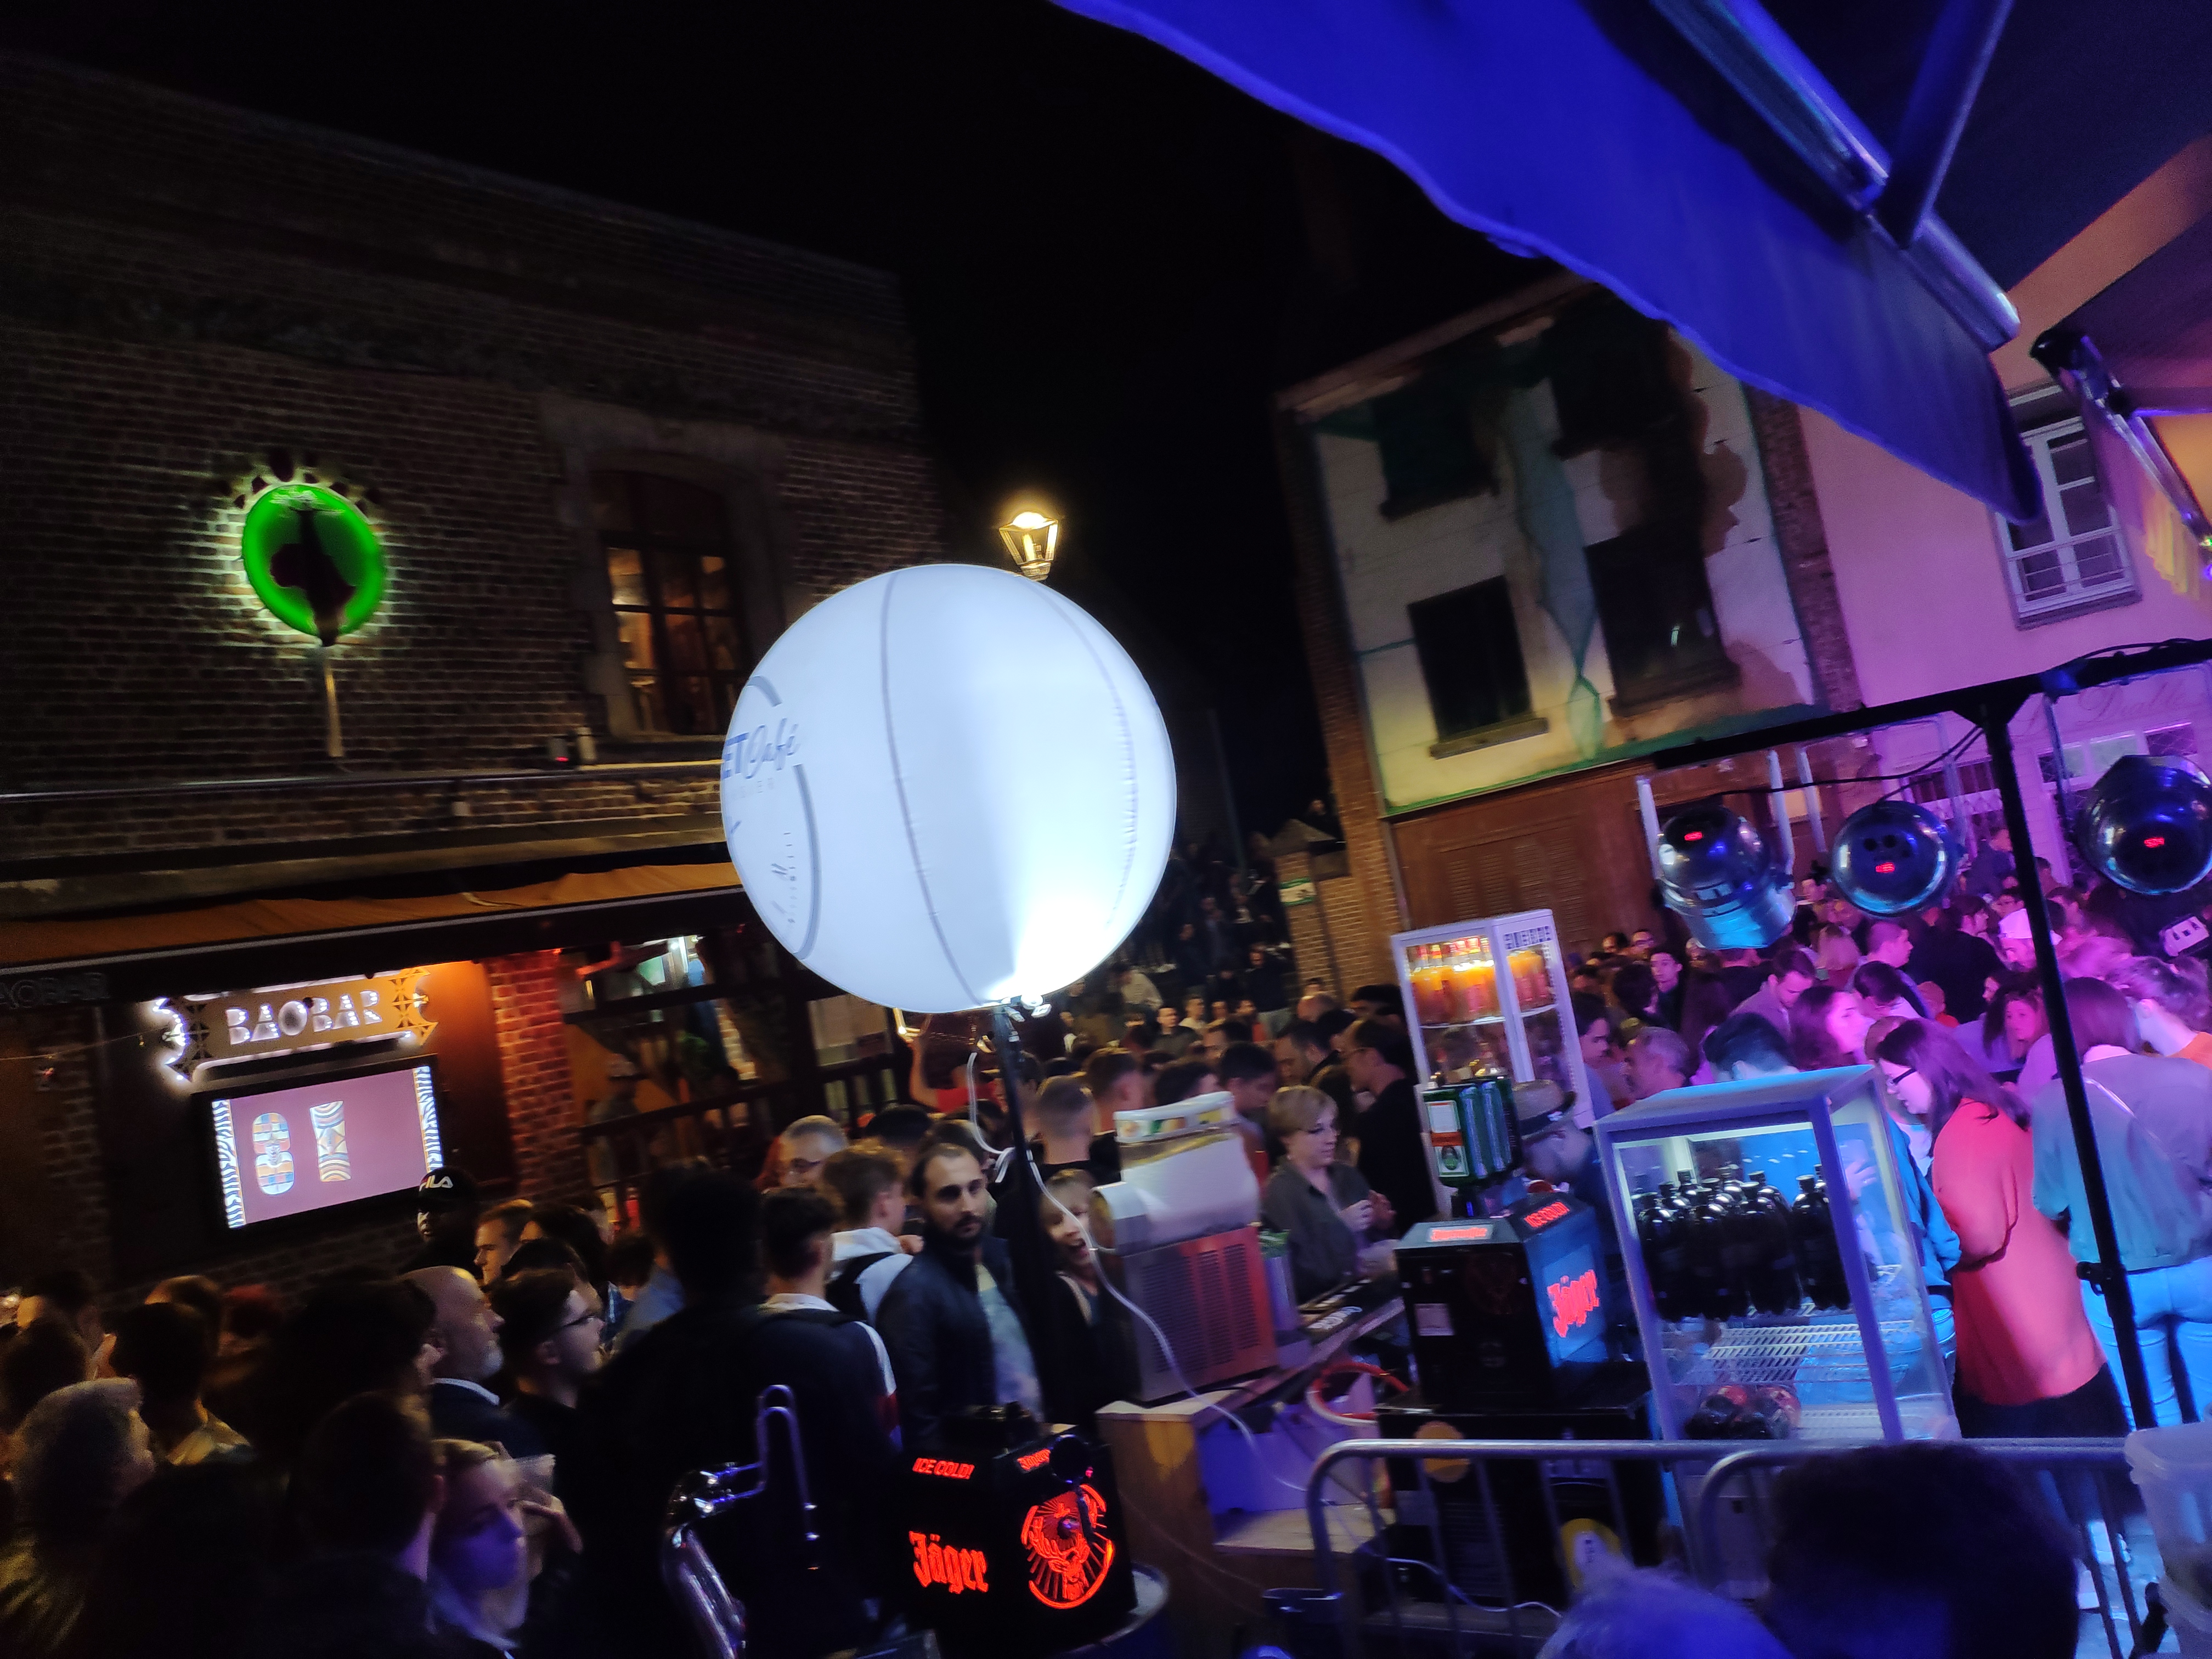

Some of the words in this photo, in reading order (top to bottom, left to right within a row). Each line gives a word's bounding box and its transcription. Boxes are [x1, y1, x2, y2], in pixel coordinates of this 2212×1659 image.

[225, 990, 383, 1045] BAOBAR
[419, 1175, 454, 1192] FILA
[912, 1457, 937, 1475] ICE
[909, 1531, 989, 1594] Jäger
